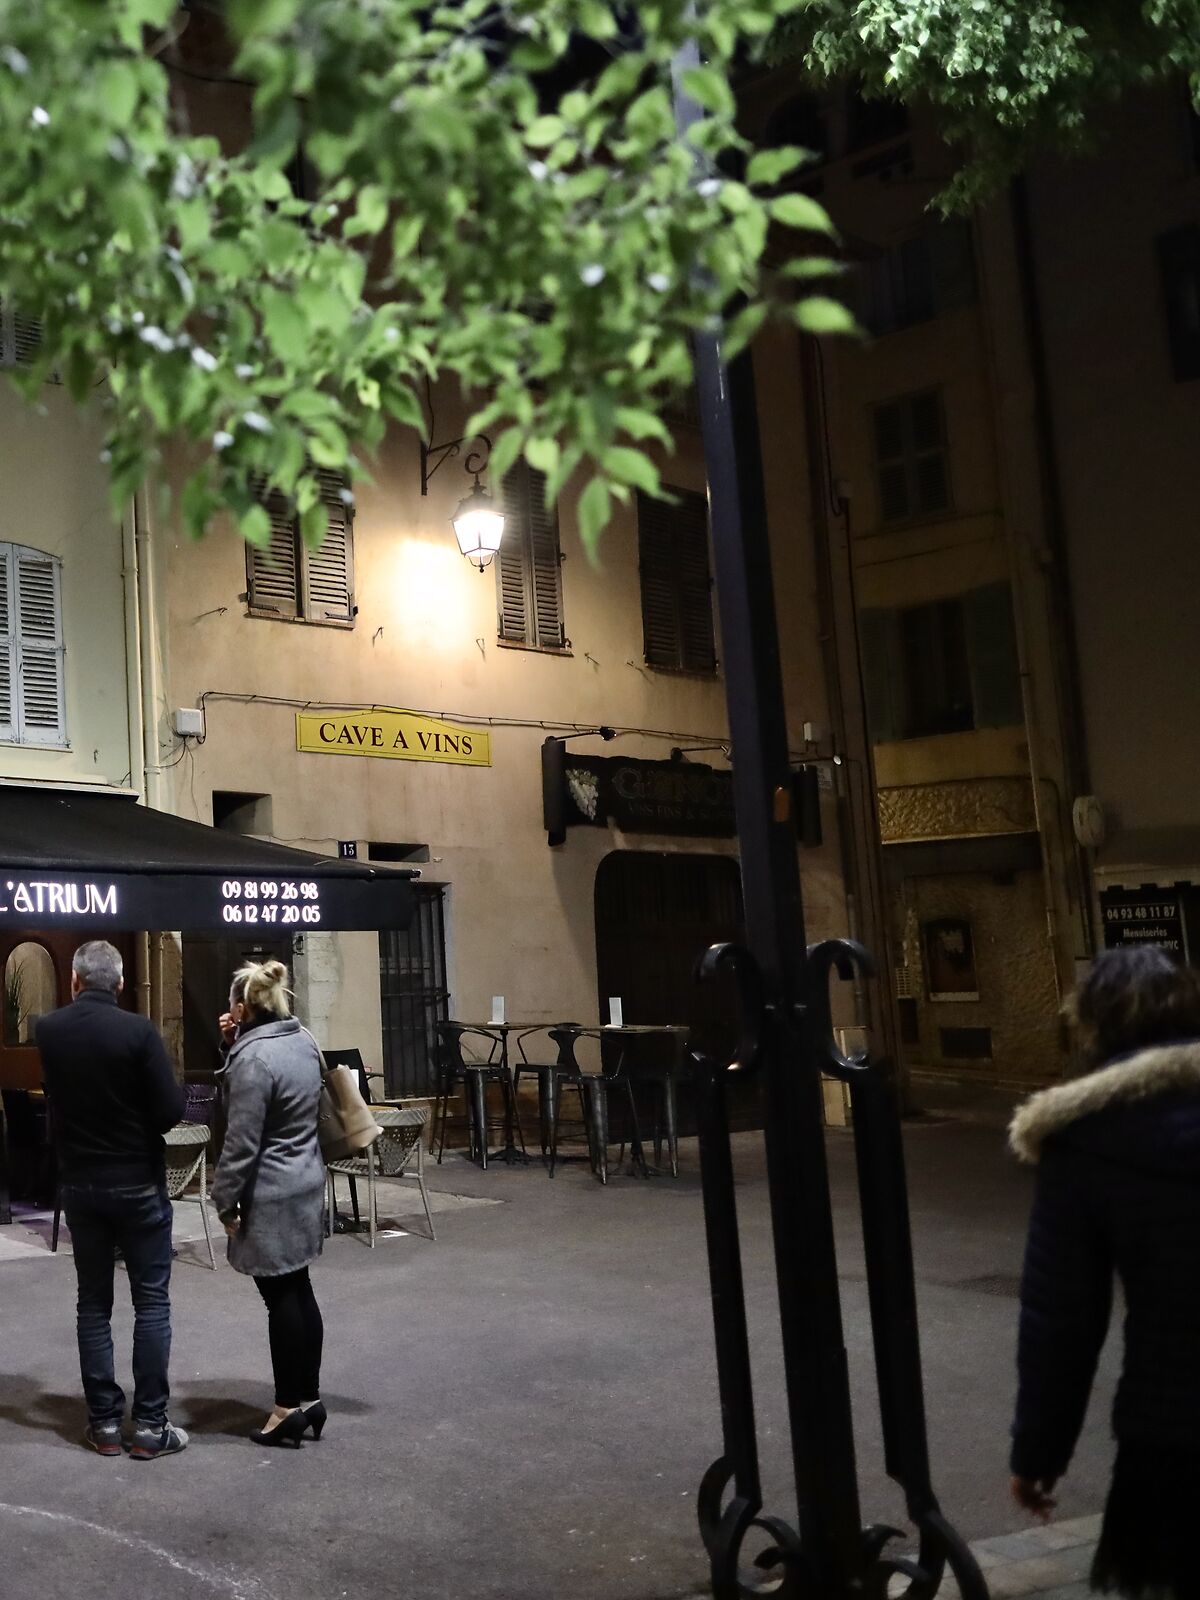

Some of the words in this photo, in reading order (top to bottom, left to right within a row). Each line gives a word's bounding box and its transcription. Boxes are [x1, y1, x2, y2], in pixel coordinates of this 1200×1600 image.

[319, 723, 384, 747] CAVE
[392, 730, 408, 749] A
[417, 732, 472, 755] VINS
[343, 844, 354, 856] 13
[222, 881, 241, 898] 09
[244, 881, 258, 898] 81
[261, 881, 278, 898] 99
[281, 882, 298, 899] 26
[300, 882, 319, 899] 98
[223, 904, 242, 922] 06
[245, 905, 258, 922] 12
[261, 904, 278, 922] 47
[282, 905, 300, 922] 20
[302, 905, 321, 922] 05
[1120, 908, 1133, 919] 93
[1149, 906, 1160, 917] 11
